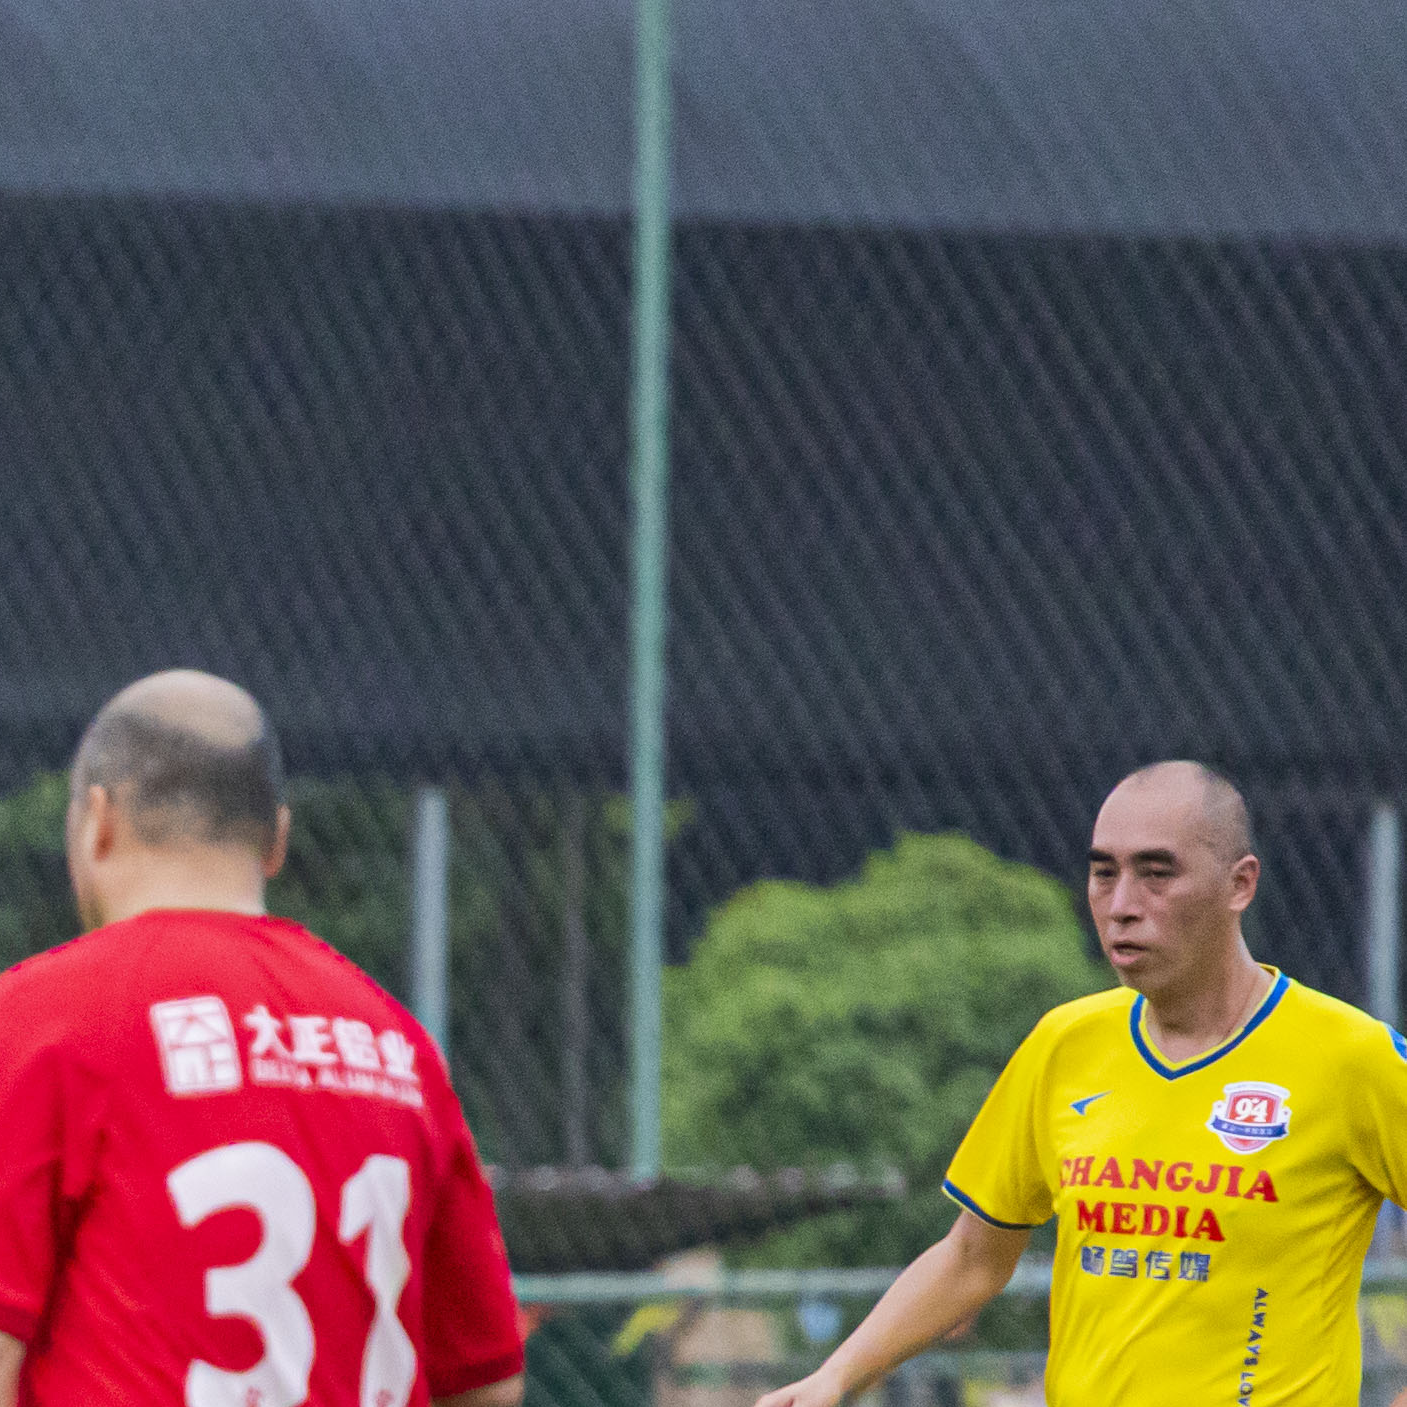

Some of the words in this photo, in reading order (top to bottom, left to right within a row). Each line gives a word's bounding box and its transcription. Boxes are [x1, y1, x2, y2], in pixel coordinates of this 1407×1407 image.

[1235, 1097, 1268, 1123] 94
[1060, 1156, 1279, 1203] CHANGJIA
[1076, 1199, 1225, 1242] MEDIA
[1244, 1288, 1269, 1366] ALWAYS
